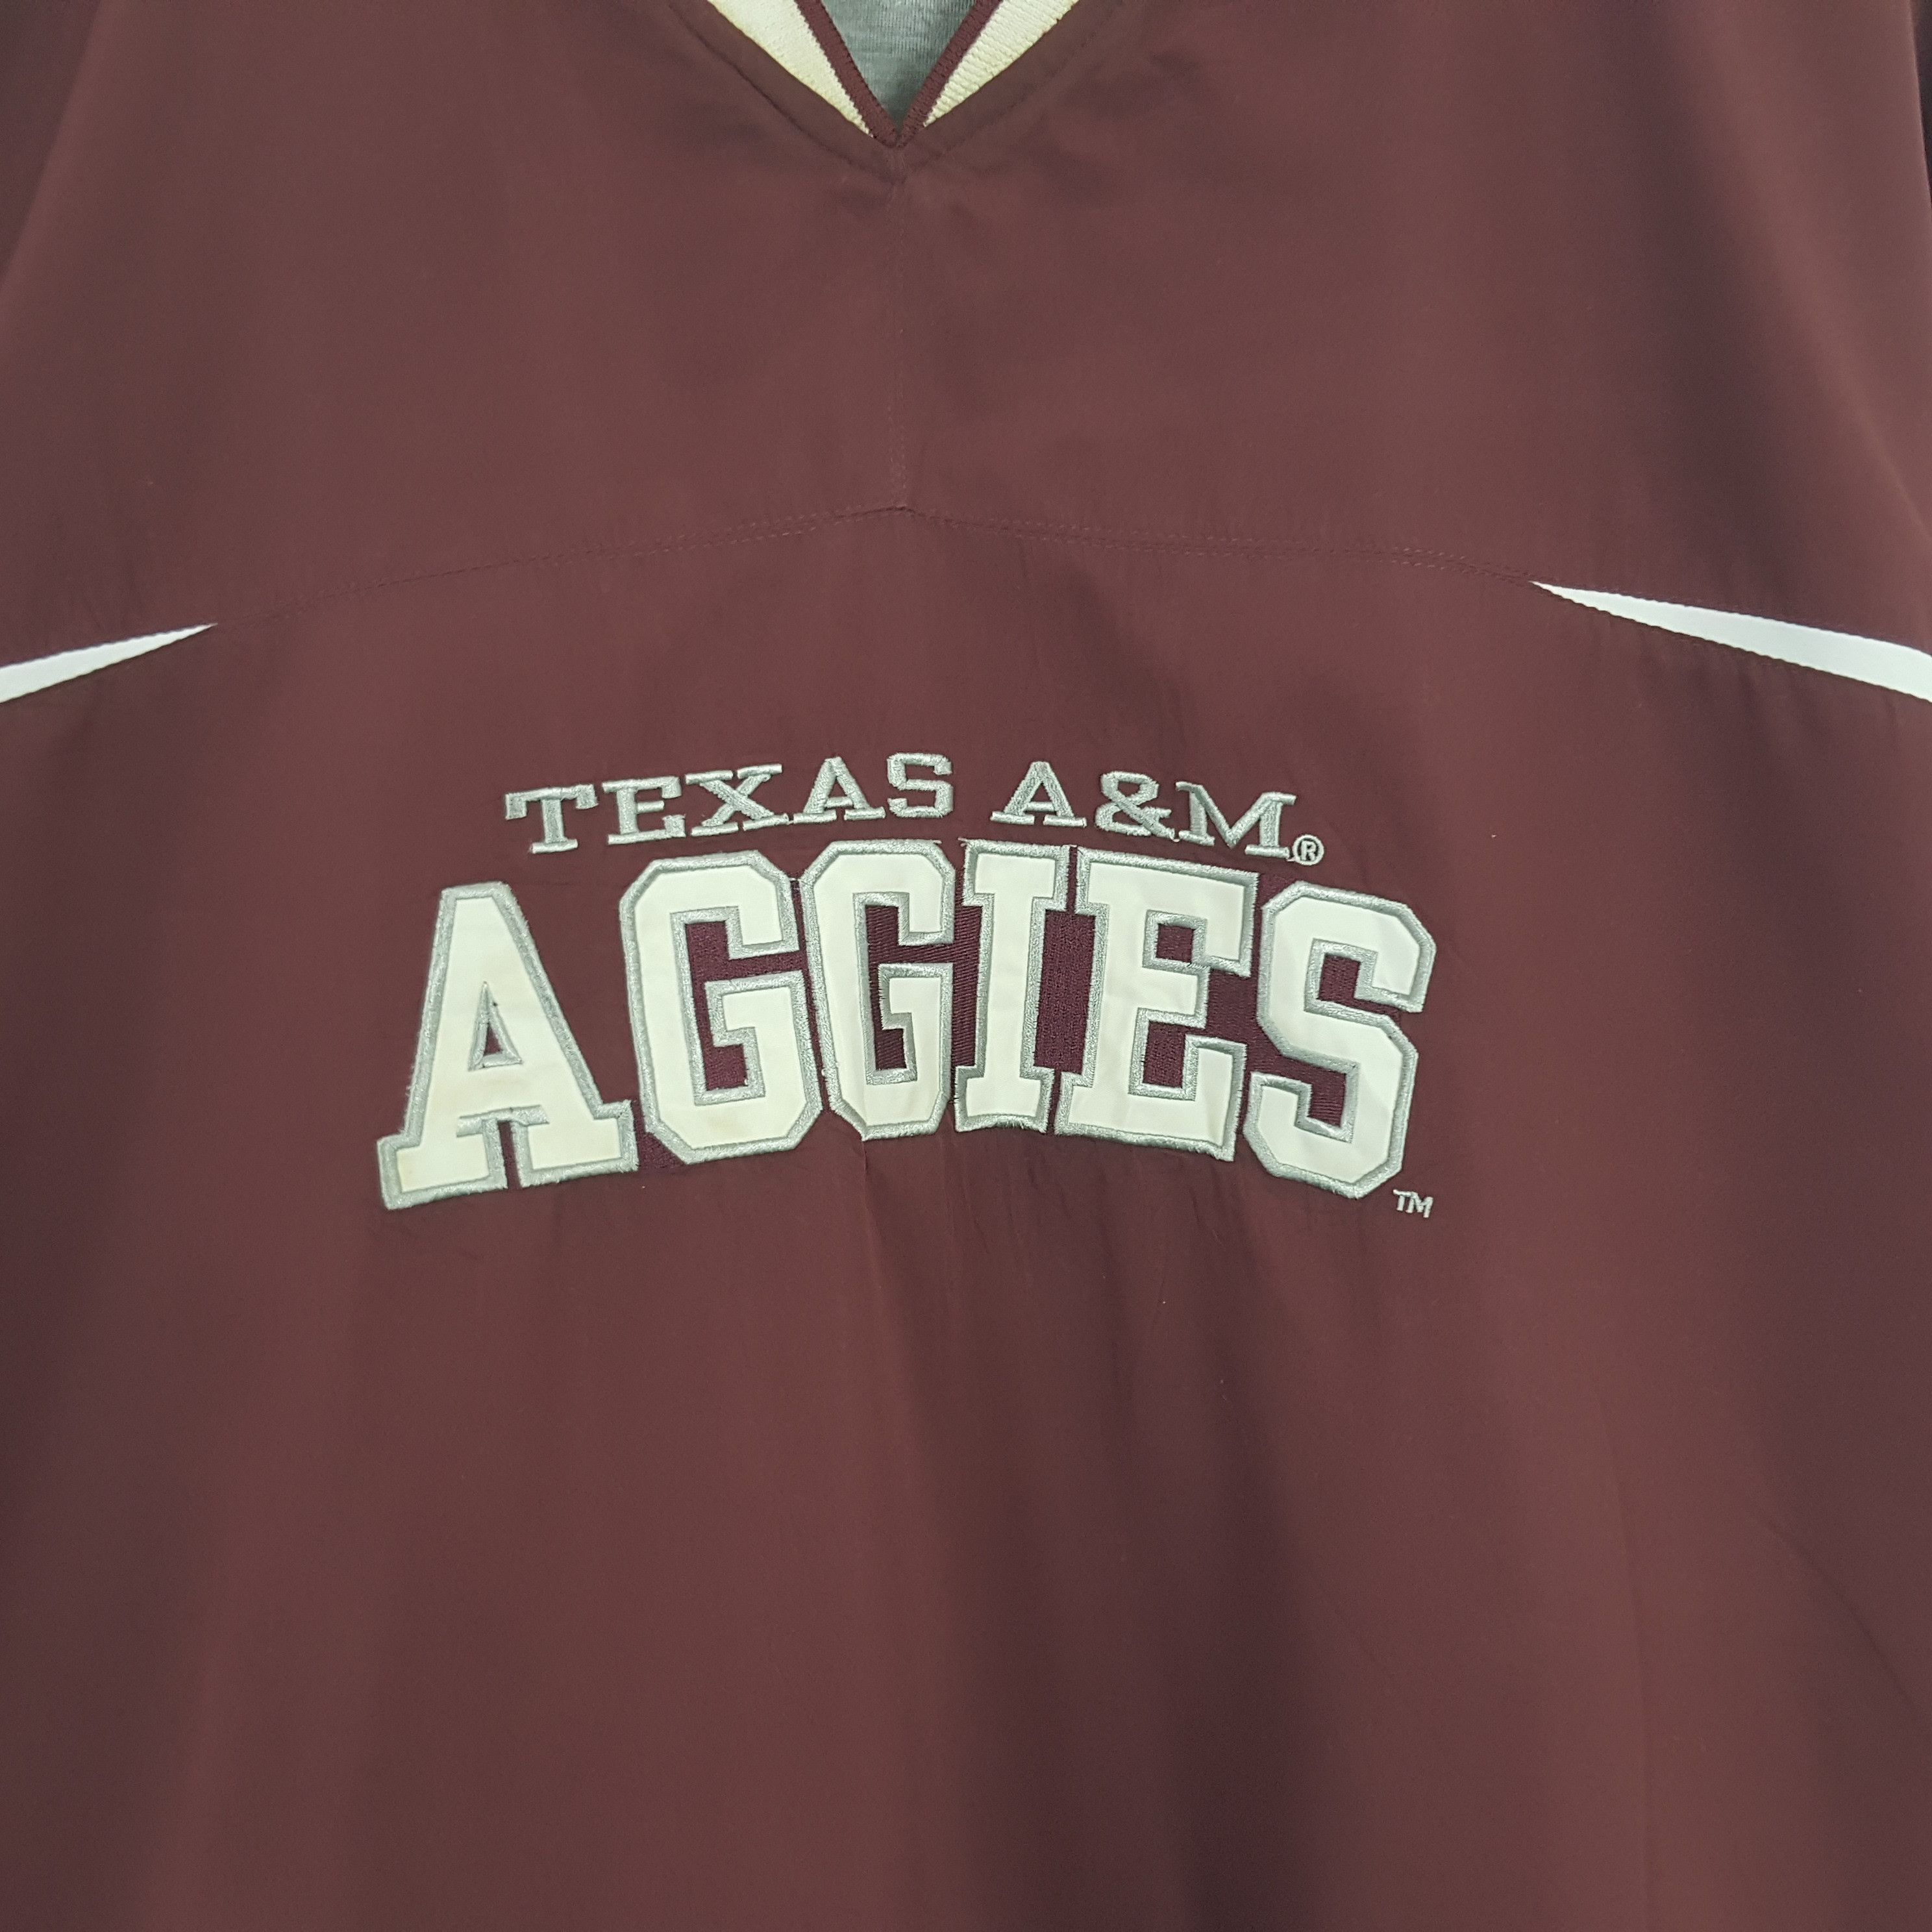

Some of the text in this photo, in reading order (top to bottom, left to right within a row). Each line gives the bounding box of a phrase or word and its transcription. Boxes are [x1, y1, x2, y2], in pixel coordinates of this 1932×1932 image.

[505, 752, 953, 854] TEXAS
[377, 837, 1437, 1210] AGGIES
[1393, 1189, 1433, 1218] TM
